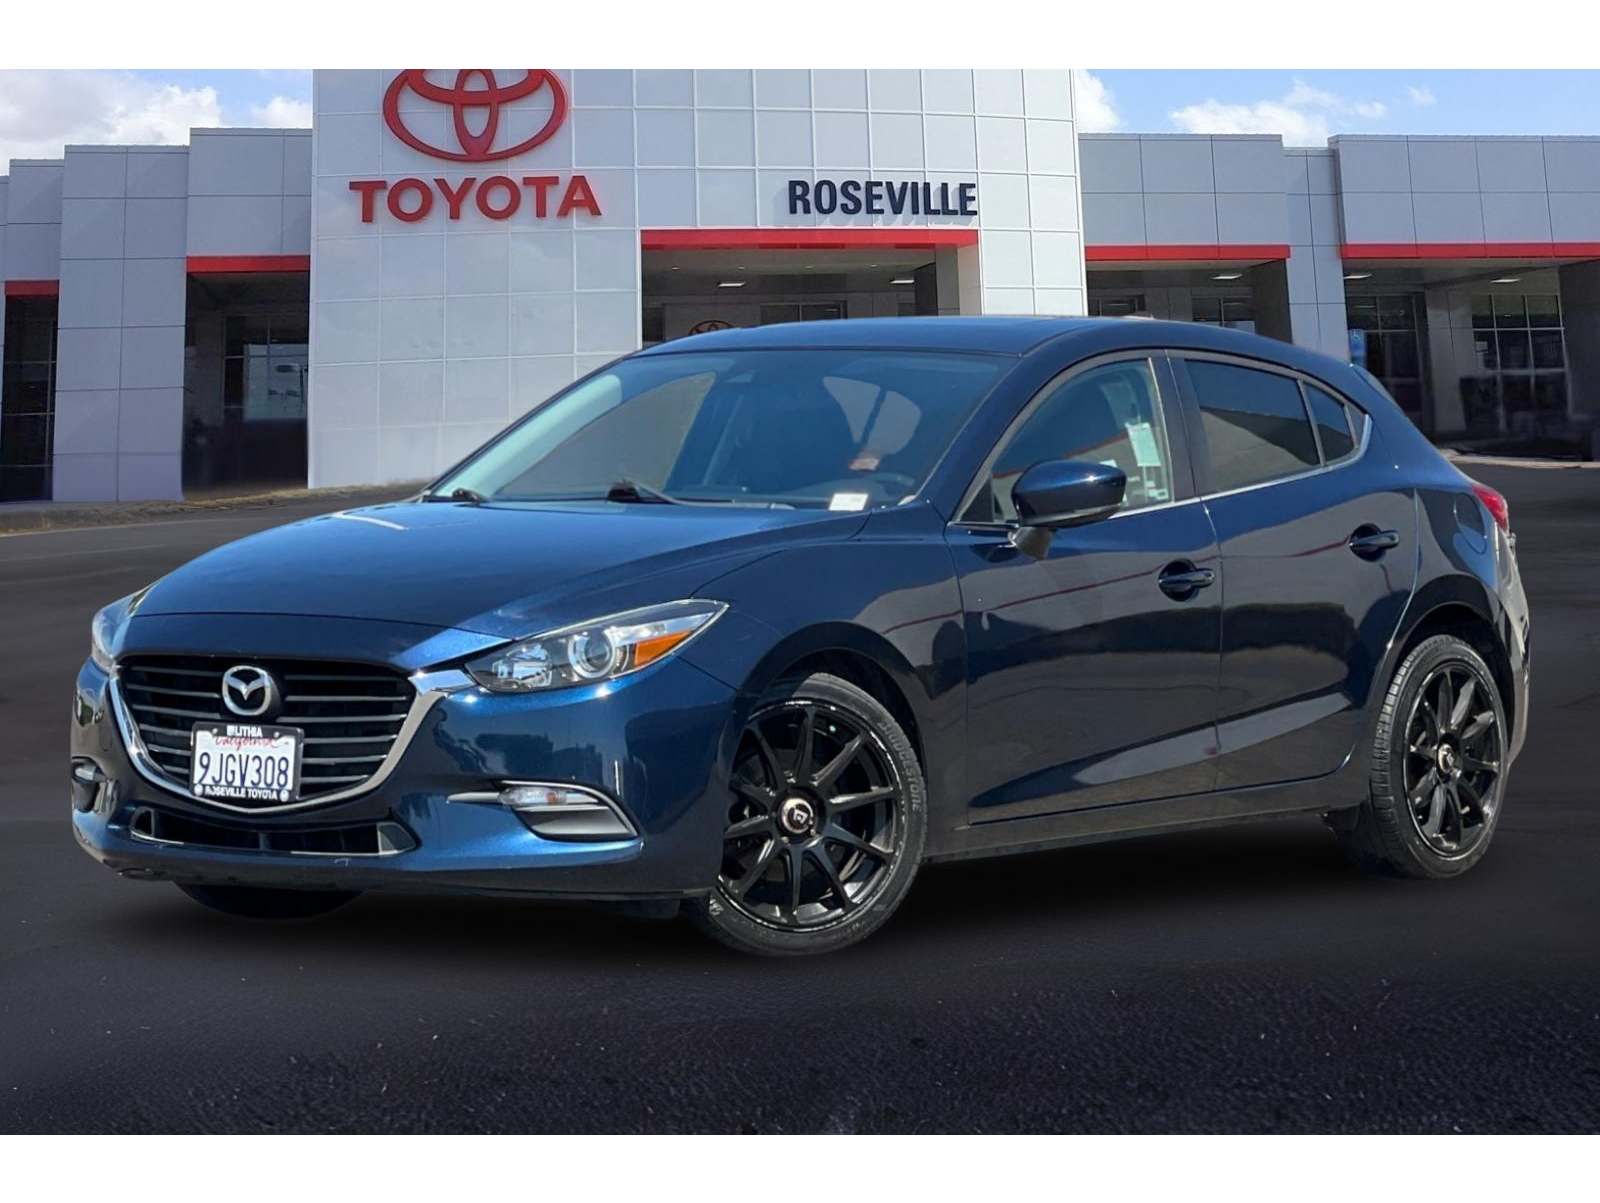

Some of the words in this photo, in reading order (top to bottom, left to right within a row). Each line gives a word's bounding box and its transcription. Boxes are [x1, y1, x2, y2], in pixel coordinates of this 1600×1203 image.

[349, 175, 602, 223] TOYOTA
[788, 180, 978, 216] ROSEVILLE
[235, 725, 263, 738] LITHIA
[198, 752, 289, 788] 9JGV308
[205, 785, 246, 798] ROSEVILLE
[247, 788, 278, 800] TOYOTA
